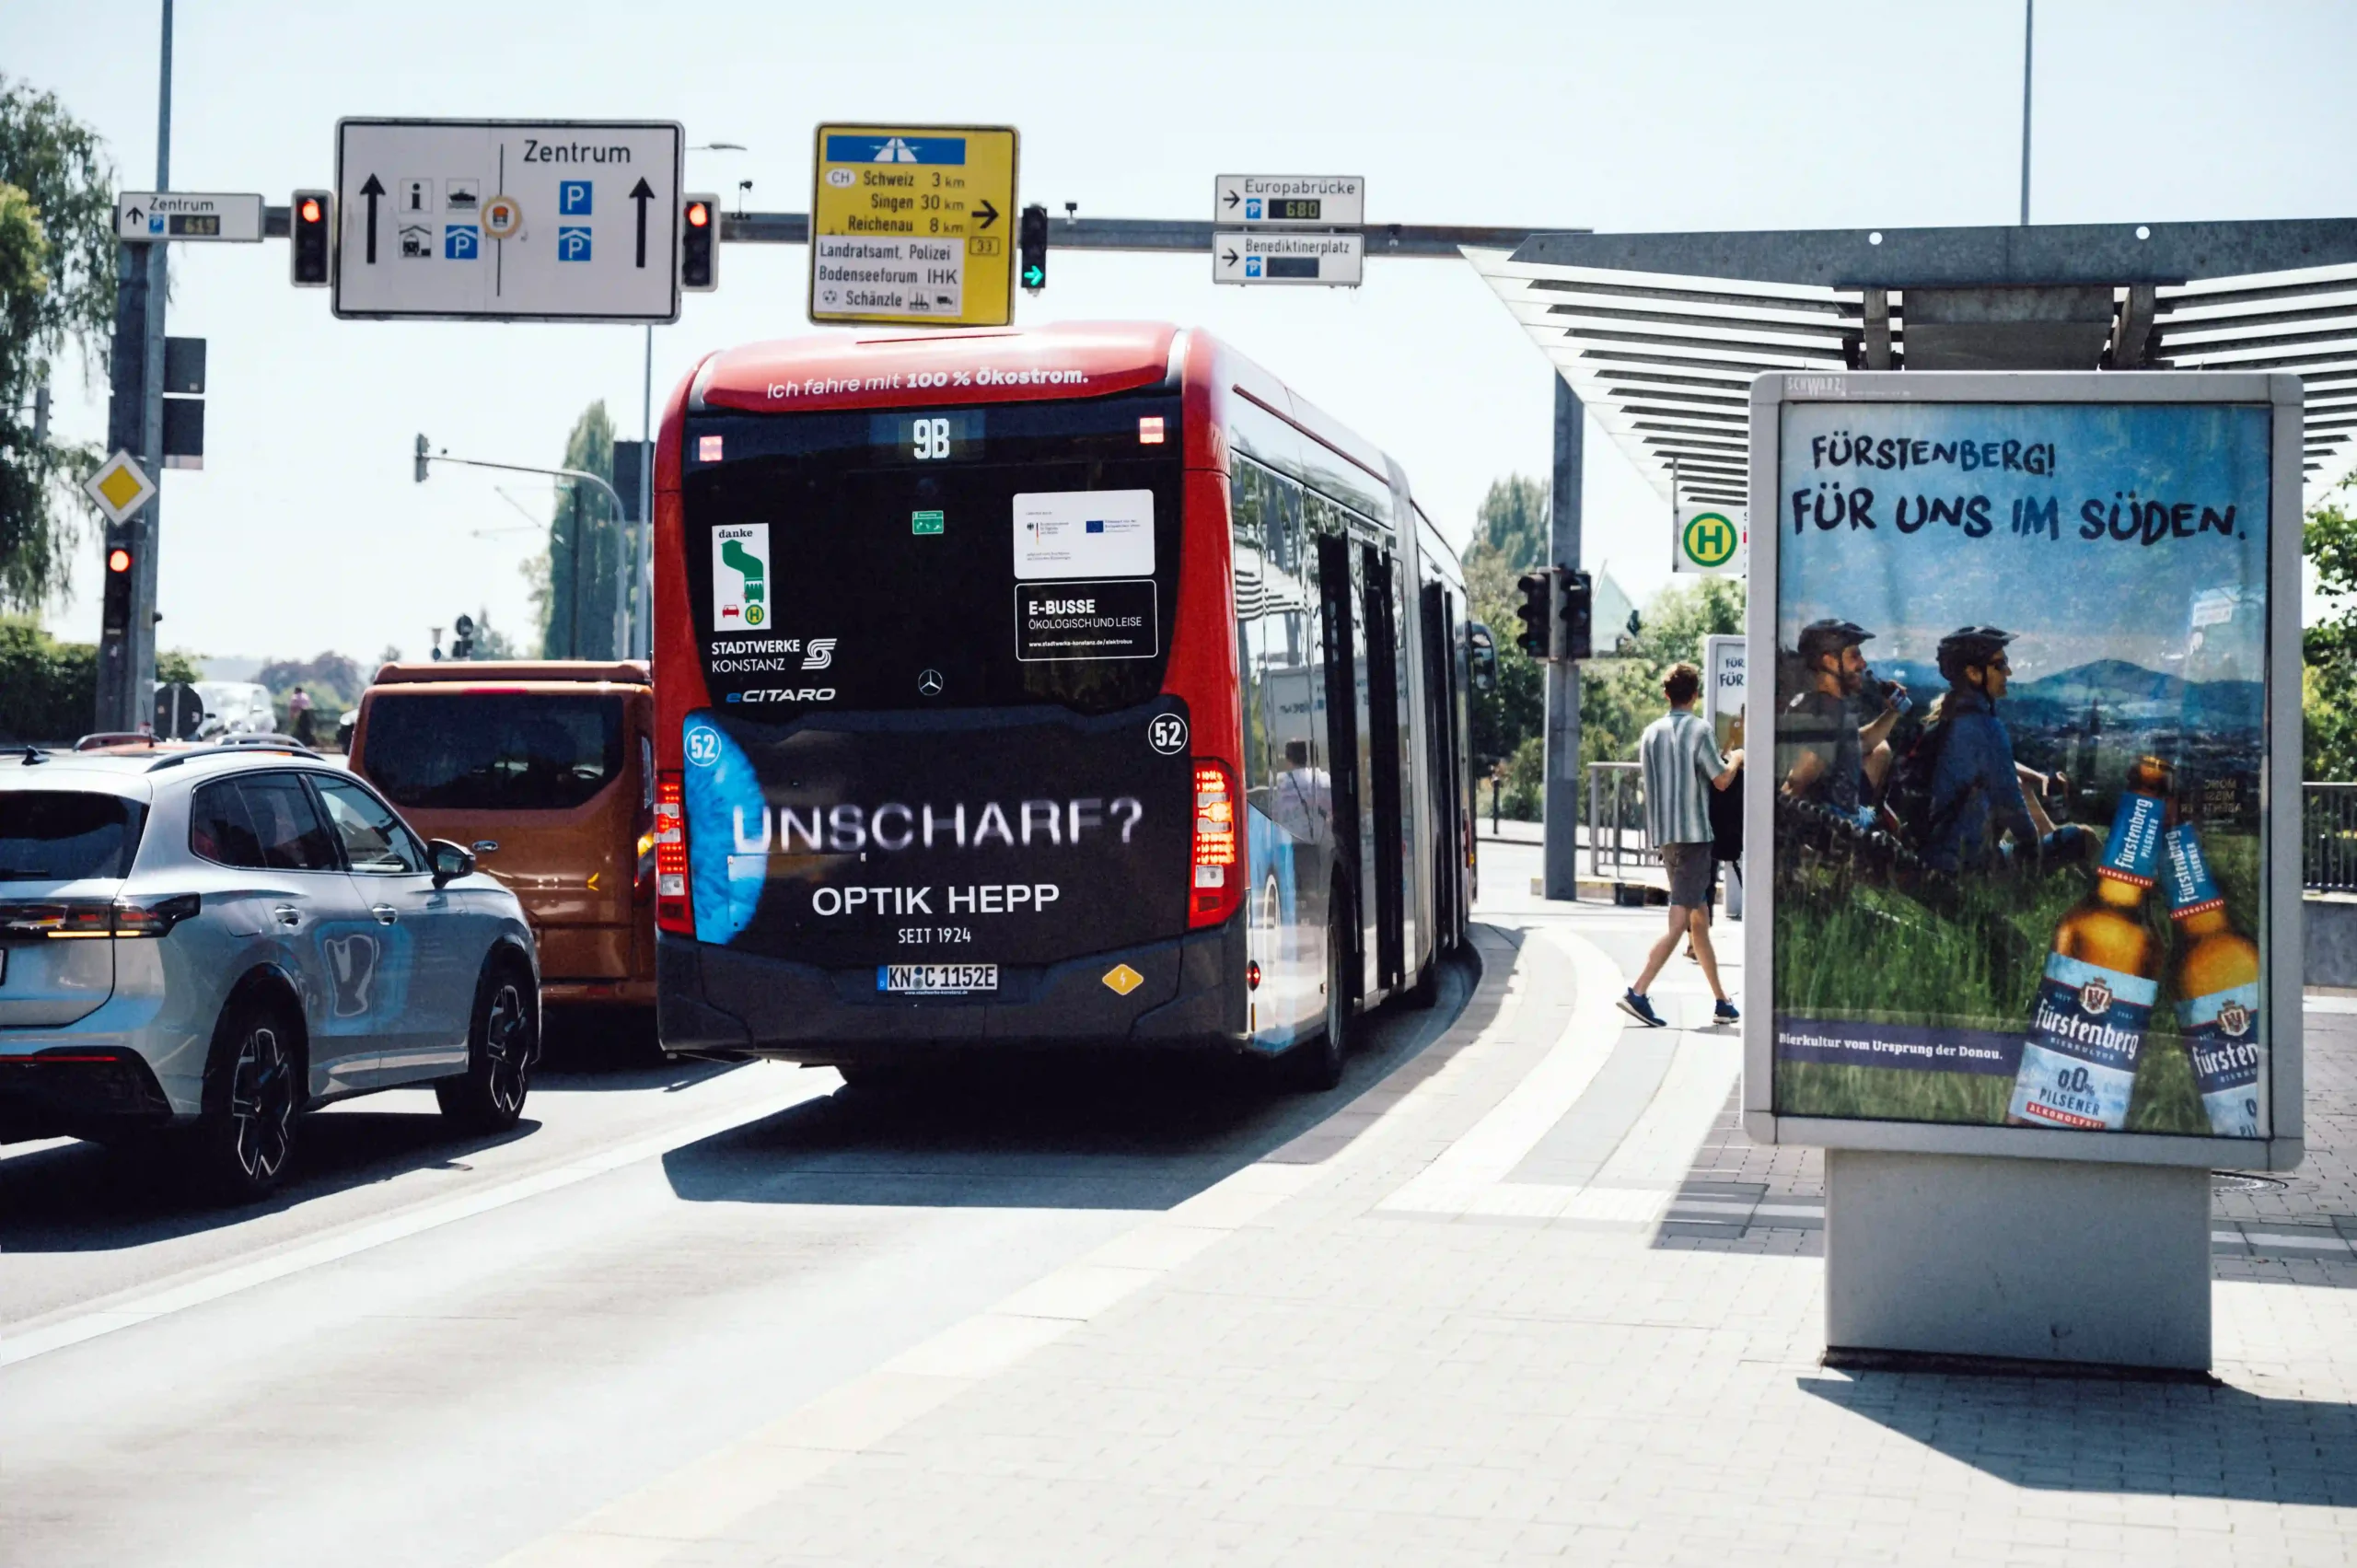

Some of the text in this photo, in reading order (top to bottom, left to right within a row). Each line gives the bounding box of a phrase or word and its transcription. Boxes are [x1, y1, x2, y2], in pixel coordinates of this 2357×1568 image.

[523, 139, 631, 164] Zentrum
[831, 171, 851, 183] CH
[864, 170, 965, 189] Schweiz 3 km
[1245, 179, 1355, 196] Europabrücke
[149, 196, 215, 212] Zentrum
[871, 193, 964, 214] Singen 30 km
[1286, 202, 1318, 217] 680
[848, 215, 964, 234] Reichenau 8 km
[910, 244, 951, 261] Polizei
[977, 240, 993, 252] 33
[1246, 238, 1350, 257] Benediktinerplatz
[819, 265, 958, 285] Bodenseeforum IHK
[845, 290, 902, 308] Schänzle
[767, 366, 1089, 399] Ich fahre mit 100 % Ökostrom.
[913, 418, 950, 459] 9B
[1812, 431, 2055, 477] FÜRSTENBERG!
[1792, 482, 2247, 546] FÜR UNS IM SÜDEN.
[718, 528, 753, 539] danke
[1028, 599, 1096, 616] E-BUSSE
[1028, 616, 1143, 630] ÖKOLOGISCH UND LEISE
[712, 639, 800, 656] STADTWERKE
[712, 657, 785, 673] KONSTANZ
[1719, 671, 1744, 688] FÜR
[726, 688, 837, 703] eCITARO
[1155, 721, 1182, 747] 52
[691, 734, 715, 760] 52
[732, 796, 1144, 854] UNSCHARF?
[2114, 798, 2154, 869] fürstenberg
[2141, 818, 2159, 858] PILSENER
[2165, 830, 2199, 903] fürstenberg
[2186, 842, 2206, 883] PILSENER
[812, 884, 1060, 916] OPTIK HEPP
[898, 927, 971, 944] SEIT 1924
[888, 967, 911, 988] KN
[924, 967, 935, 988] C
[940, 966, 995, 988] 1152E
[2036, 997, 2140, 1061] fürstenberg
[1778, 1032, 2003, 1061] Bierkultur vom Ursprung der Donau.
[2058, 1067, 2096, 1098] 0,0%
[2038, 1087, 2100, 1117] PILSENER
